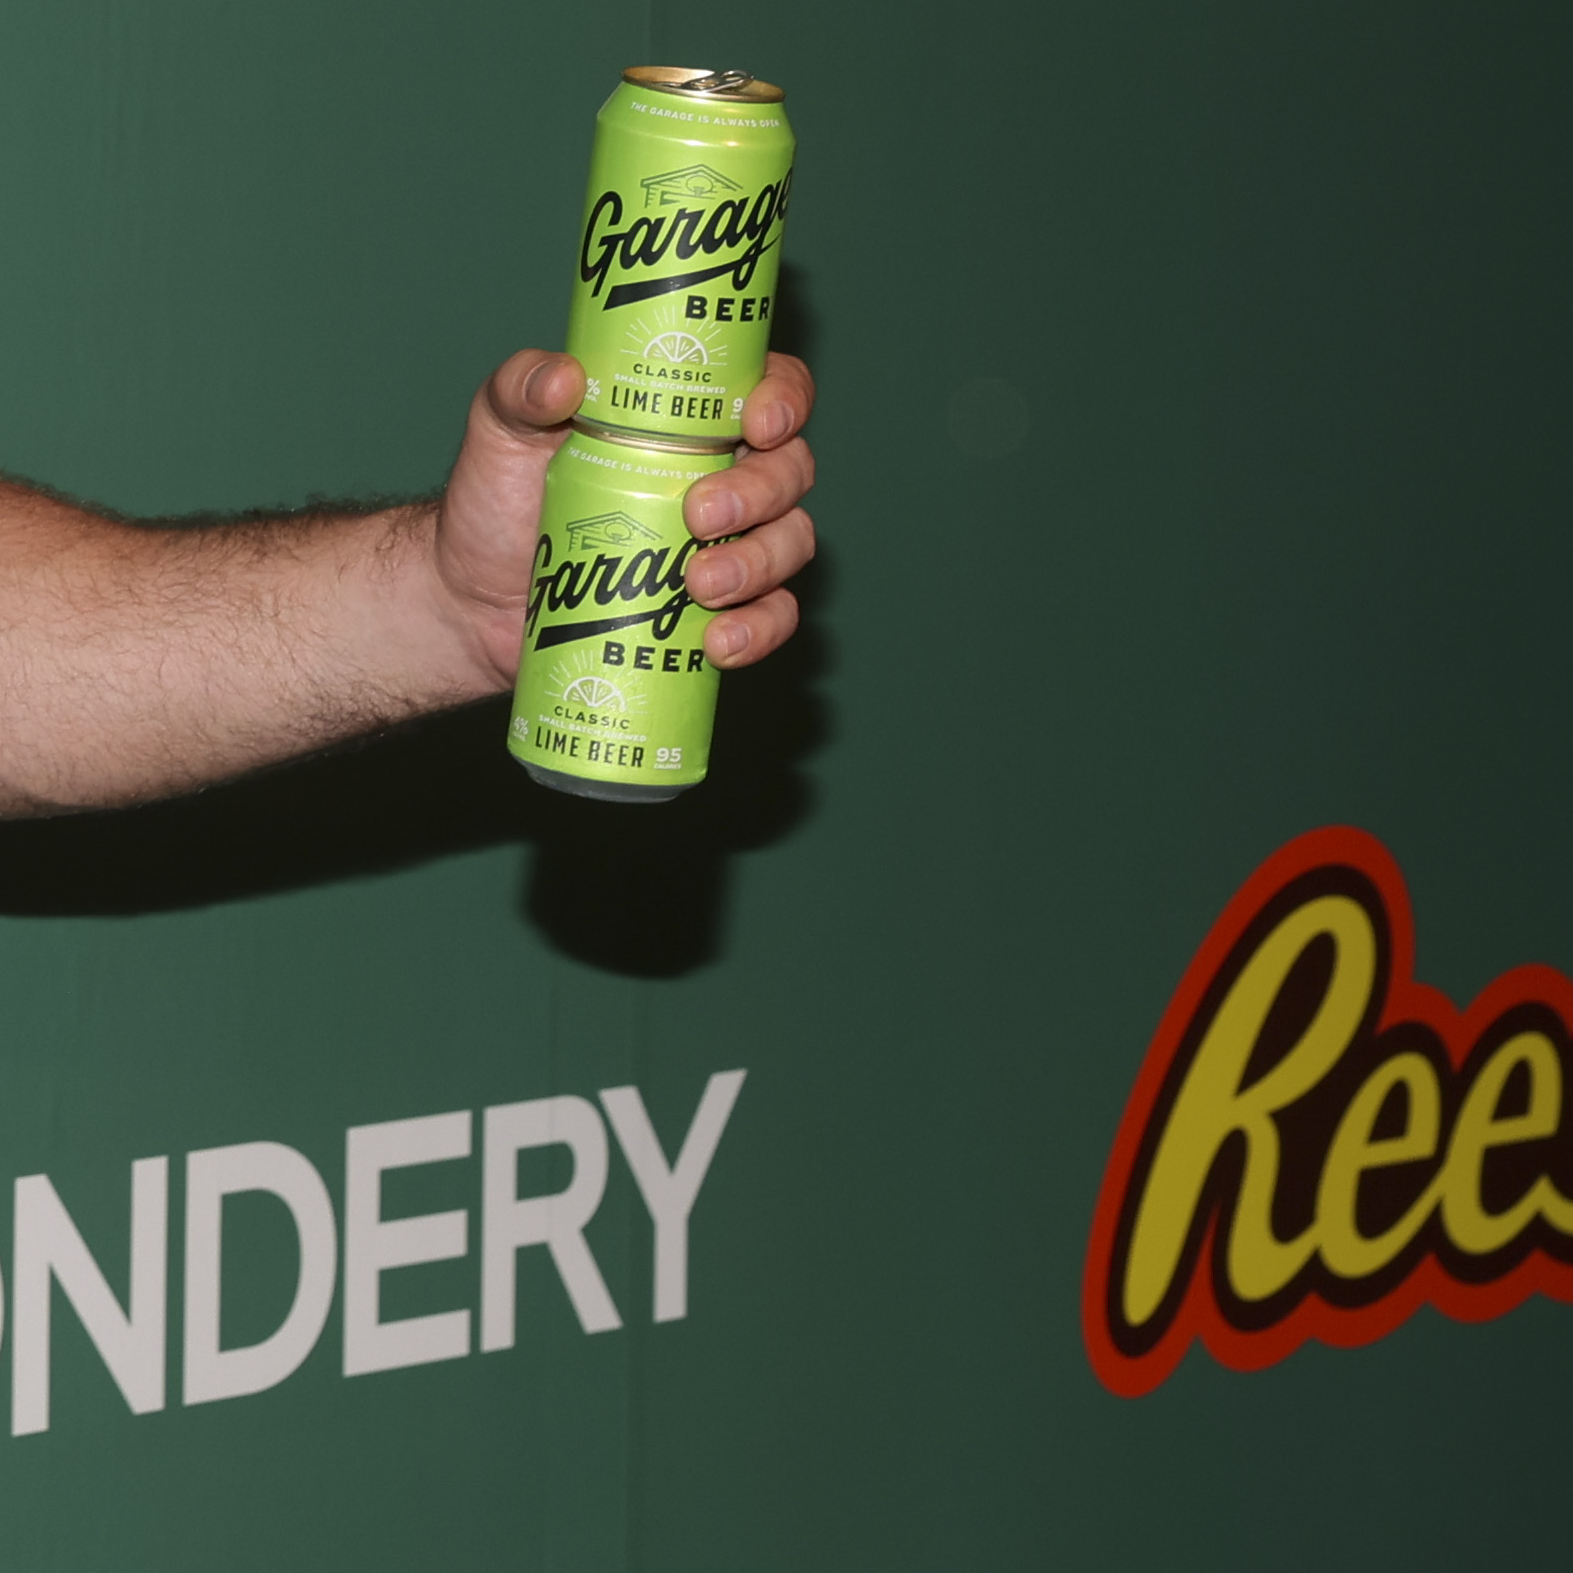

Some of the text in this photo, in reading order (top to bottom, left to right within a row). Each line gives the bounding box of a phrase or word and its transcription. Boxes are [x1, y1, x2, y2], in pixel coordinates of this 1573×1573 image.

[630, 101, 780, 128] THE GARAGE IS ALWAYS OPEN
[685, 295, 770, 323] BEER
[614, 373, 727, 395] SMALL BATCH BREWED
[633, 363, 712, 383] CLASSIC
[611, 385, 724, 420] LIME BEER
[732, 396, 745, 413] 9
[581, 452, 618, 469] GARAGE
[621, 462, 632, 471] IS
[635, 466, 683, 479] ALWAYS
[525, 533, 727, 641] Garag
[603, 640, 704, 673] BEER
[538, 714, 565, 729] SMALL
[568, 723, 603, 737] BATCH
[554, 705, 631, 730] CLASSIC
[535, 725, 645, 768] LIME BEER
[656, 747, 683, 763] 95
